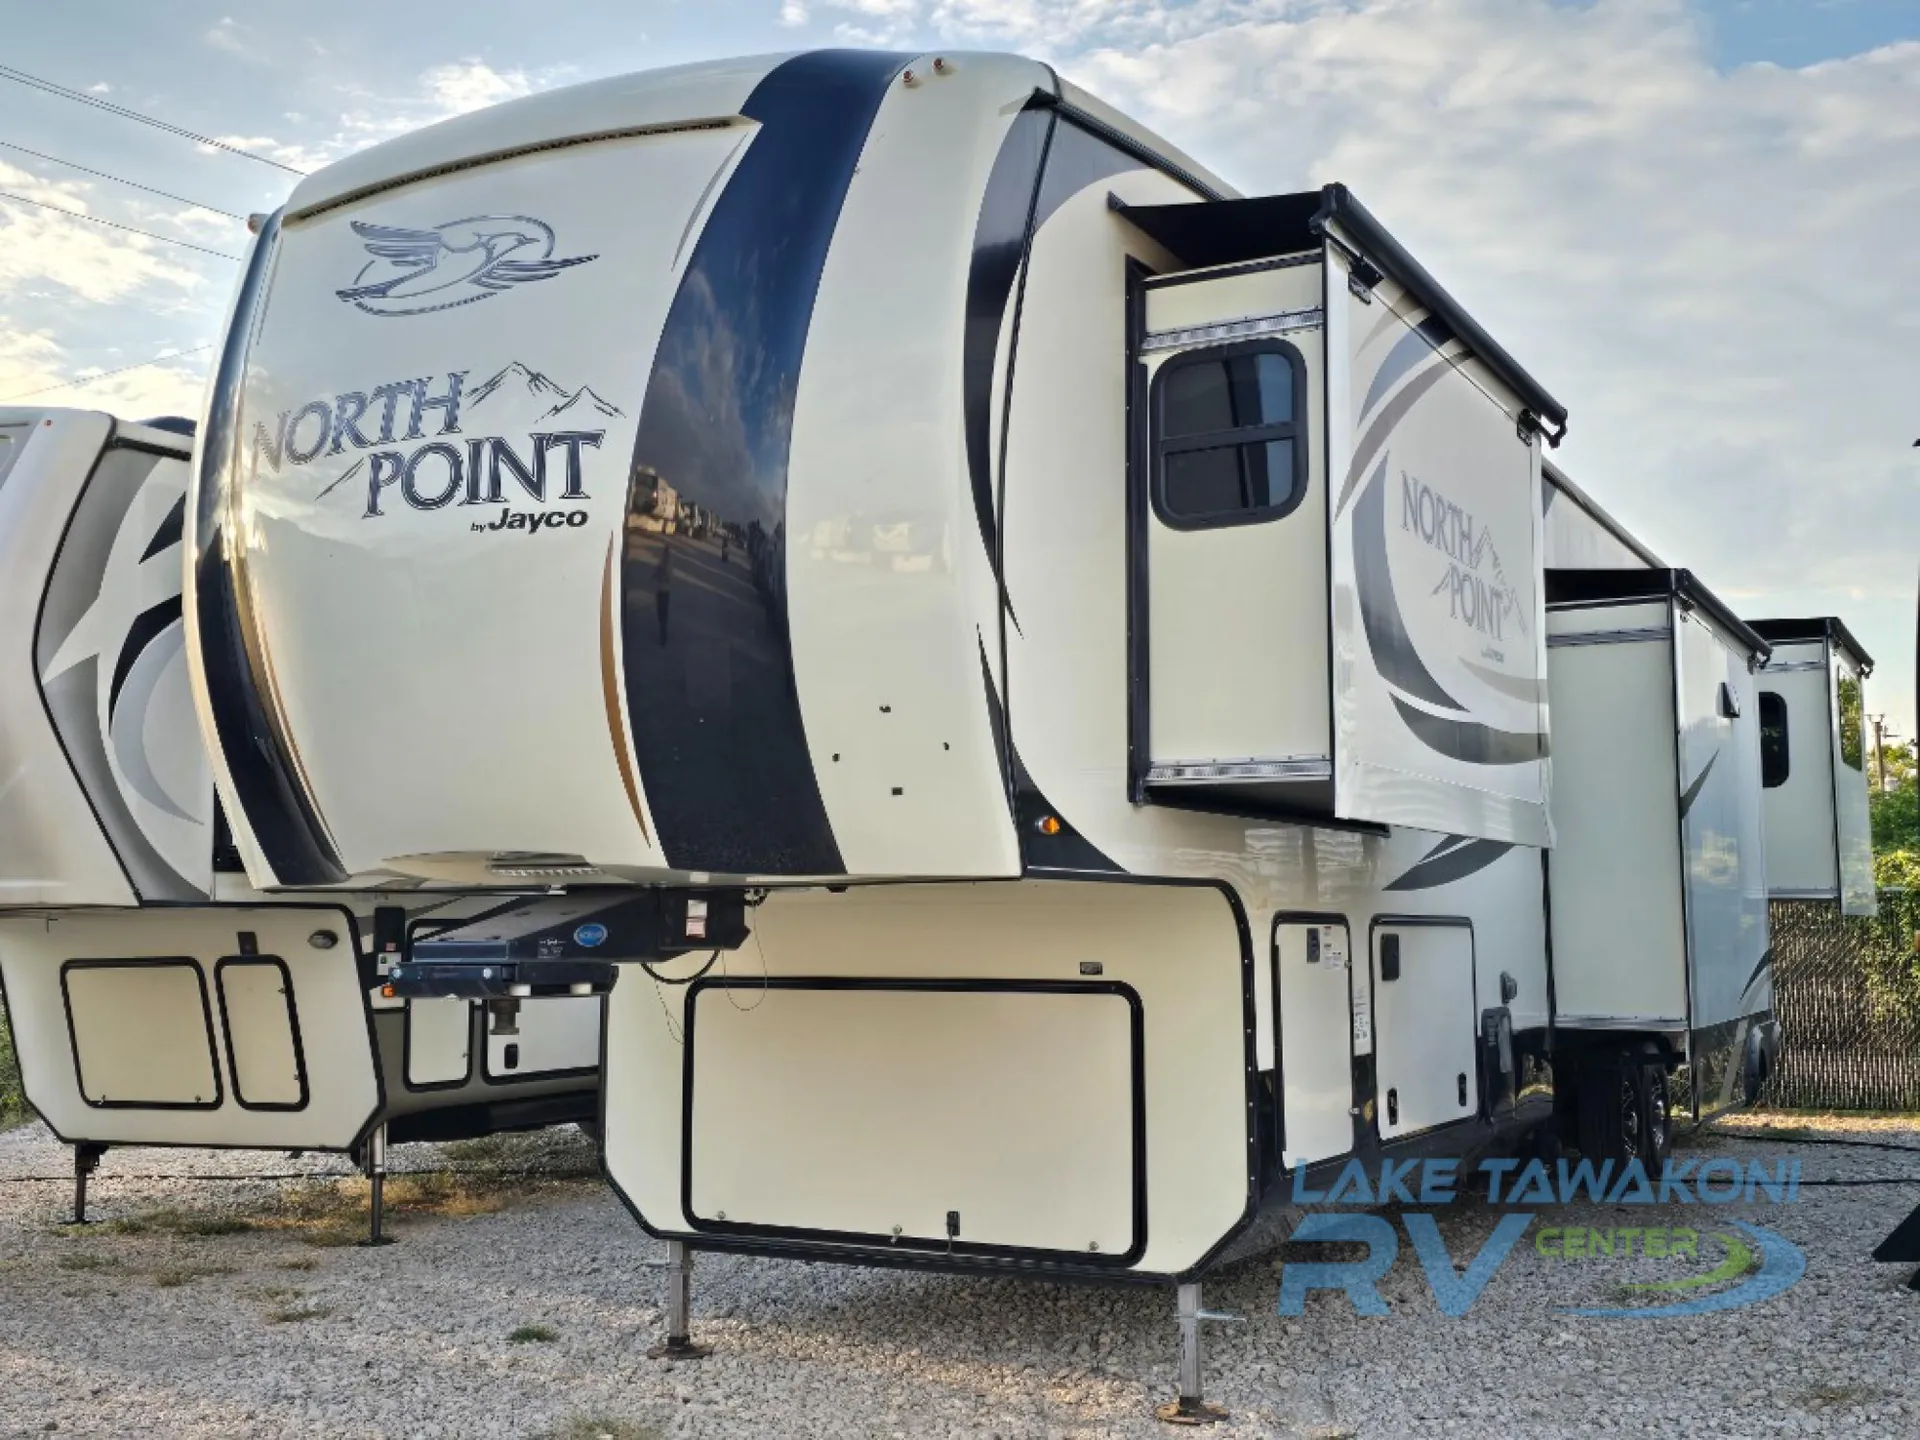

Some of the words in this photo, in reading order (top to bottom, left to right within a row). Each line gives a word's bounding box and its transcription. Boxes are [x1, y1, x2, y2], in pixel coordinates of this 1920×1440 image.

[252, 370, 470, 480] NORTH
[361, 428, 606, 520] POINT
[1400, 470, 1474, 570] NORTH
[470, 522, 486, 533] by
[487, 507, 589, 535] Jayco
[1449, 562, 1504, 642] POINT
